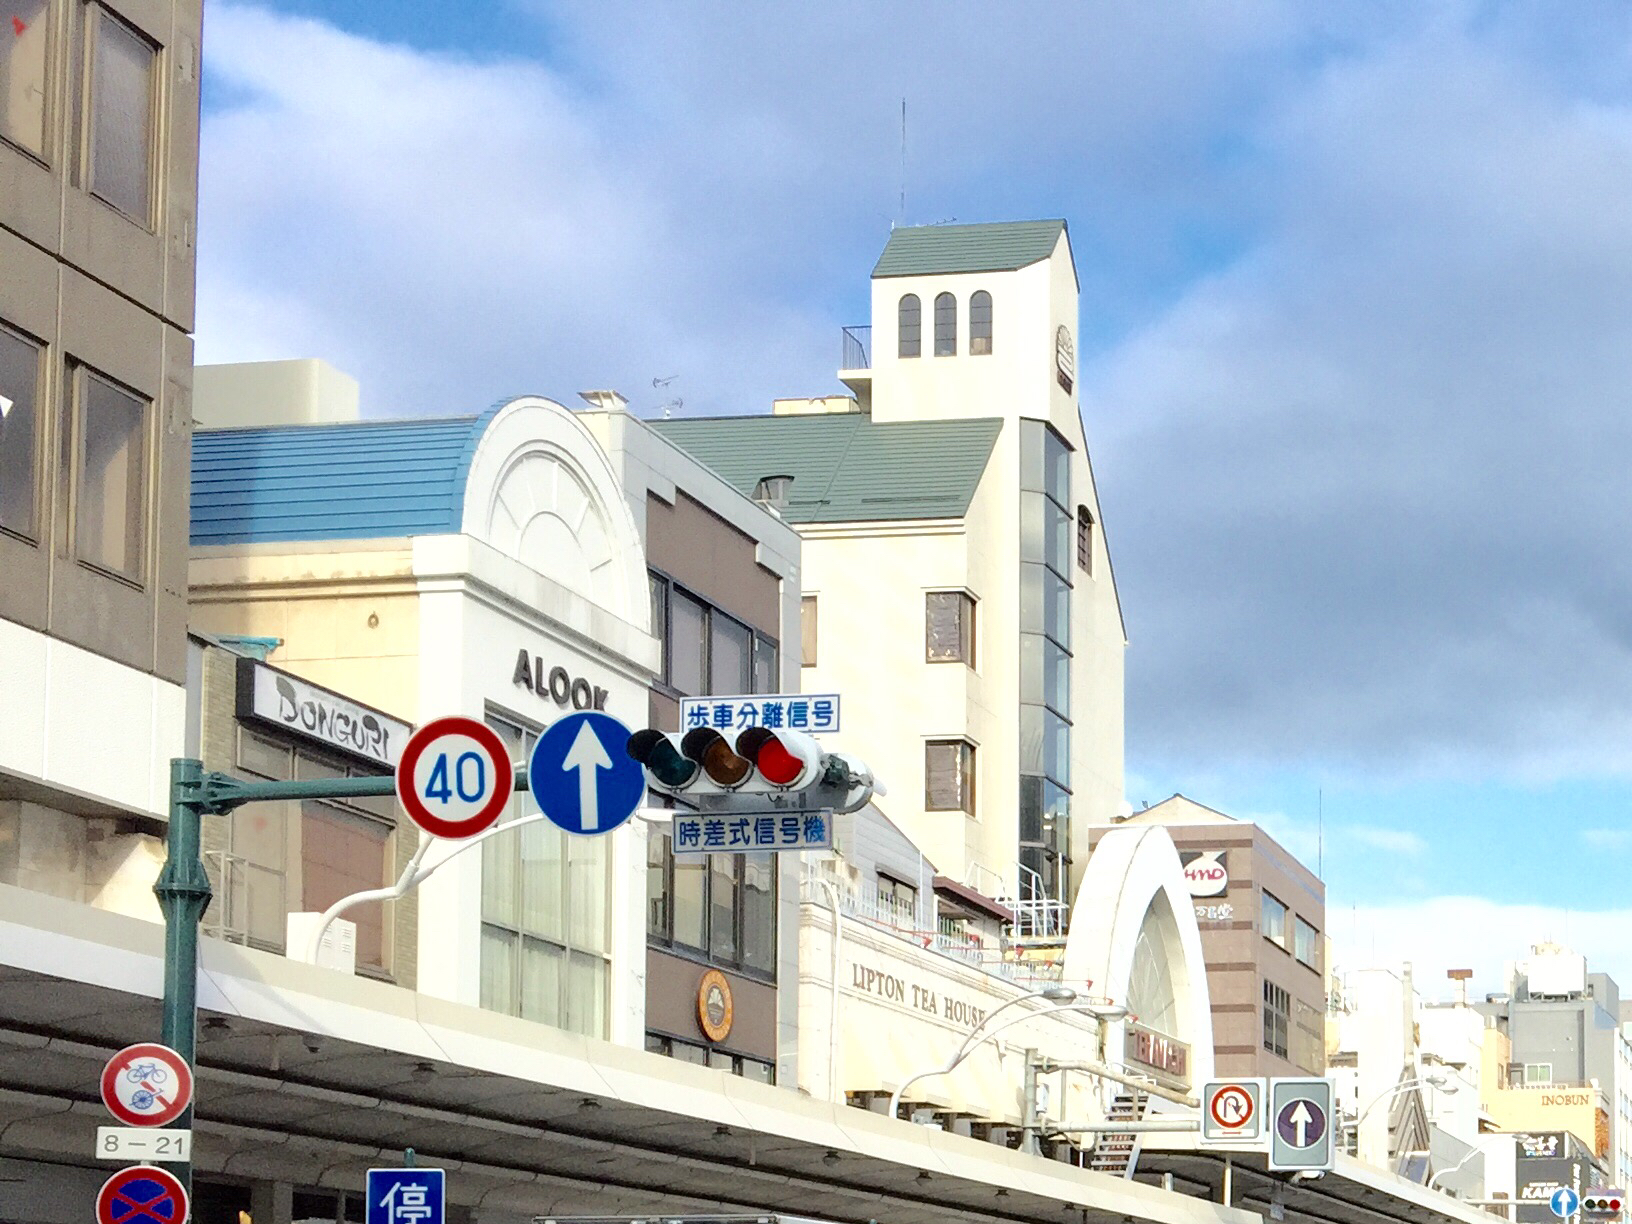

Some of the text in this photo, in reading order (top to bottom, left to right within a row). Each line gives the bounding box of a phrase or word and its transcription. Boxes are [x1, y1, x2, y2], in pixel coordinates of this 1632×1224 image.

[513, 649, 609, 711] ALOOK
[276, 676, 390, 759] DONGURI
[687, 700, 835, 730] 歩車分離信号
[425, 751, 486, 804] 40
[678, 815, 826, 848] 時差式信号機
[853, 963, 987, 1031] LIPTON TEA HOUSE
[1541, 1094, 1590, 1106] INOBUN
[1522, 1186, 1554, 1199] KAM
